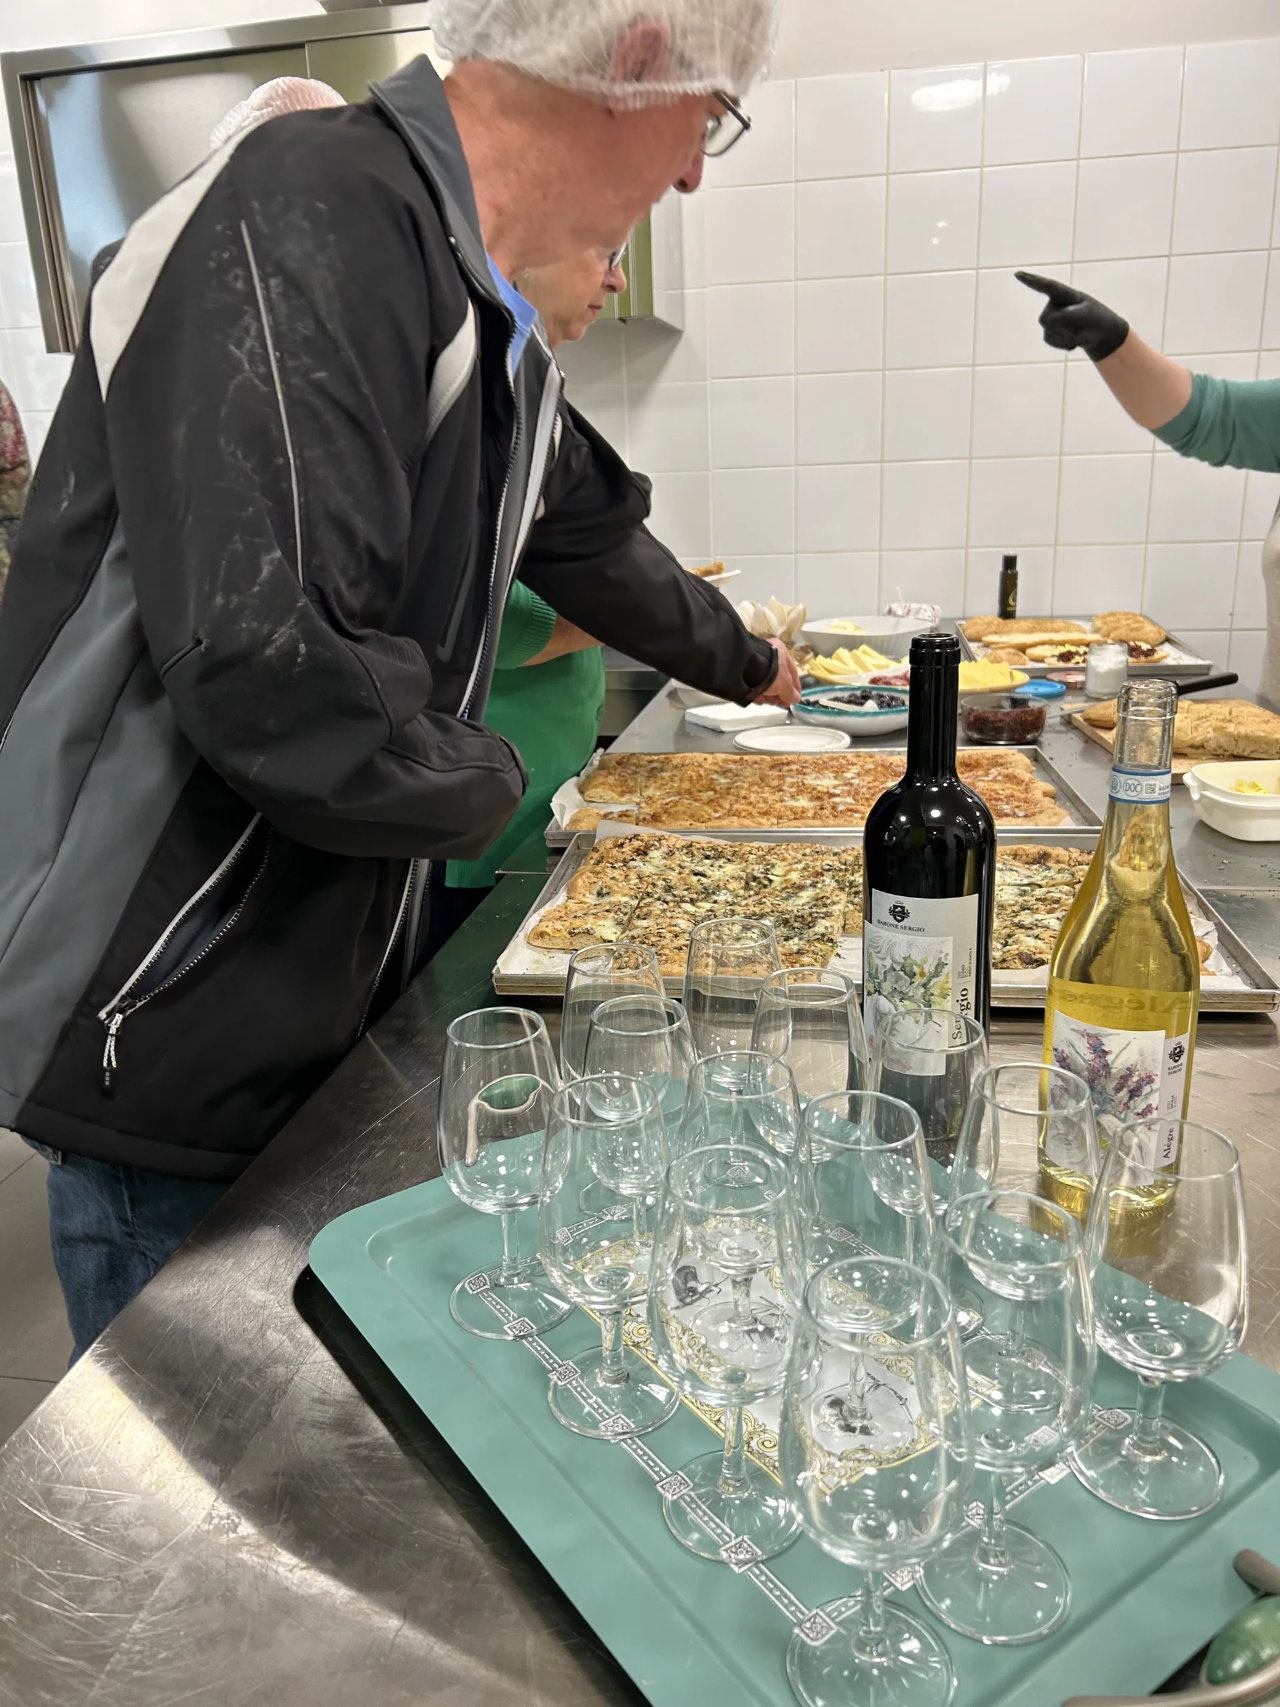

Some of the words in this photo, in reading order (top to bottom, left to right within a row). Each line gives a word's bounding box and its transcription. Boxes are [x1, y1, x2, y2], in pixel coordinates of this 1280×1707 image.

[1125, 782, 1140, 793] DOC
[877, 919, 900, 930] BARONE
[952, 988, 972, 1040] Sergio
